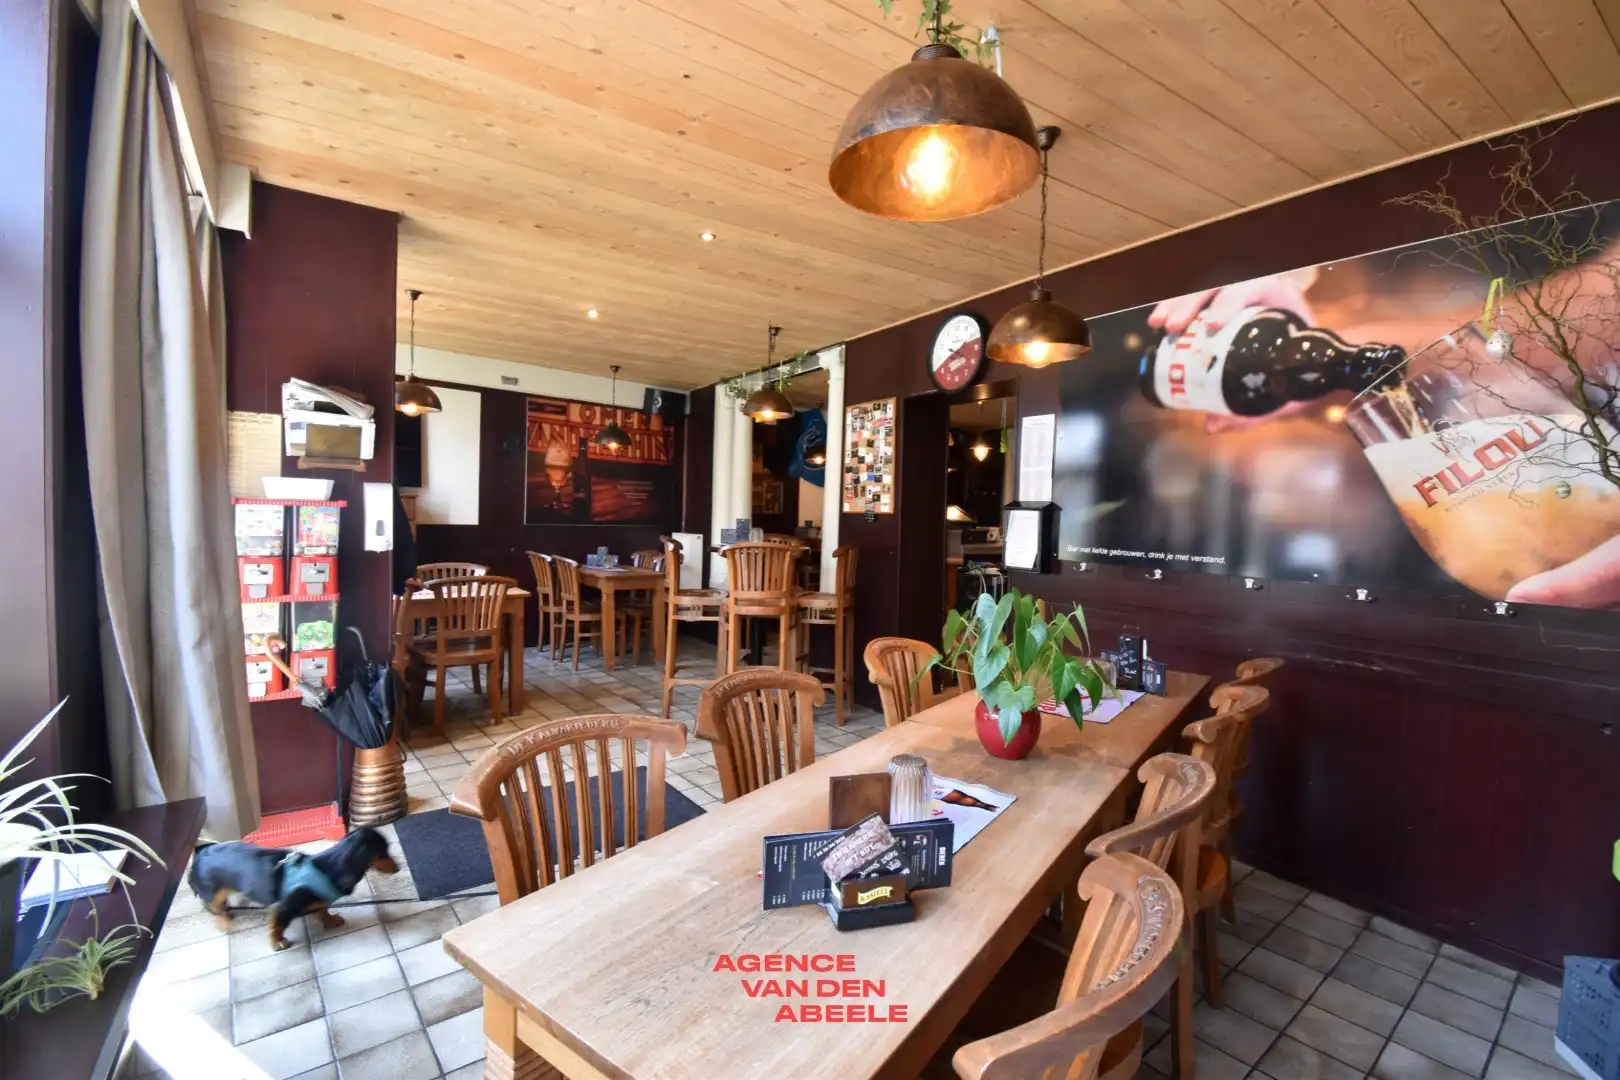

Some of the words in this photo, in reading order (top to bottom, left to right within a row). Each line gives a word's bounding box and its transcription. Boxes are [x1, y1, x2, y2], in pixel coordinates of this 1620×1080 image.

[1413, 420, 1546, 508] FILOU
[1109, 548, 1147, 558] gebrouwen,
[1148, 551, 1165, 559] drink
[1166, 552, 1173, 561] je
[1175, 553, 1189, 561] met
[1191, 554, 1226, 564] verstand.
